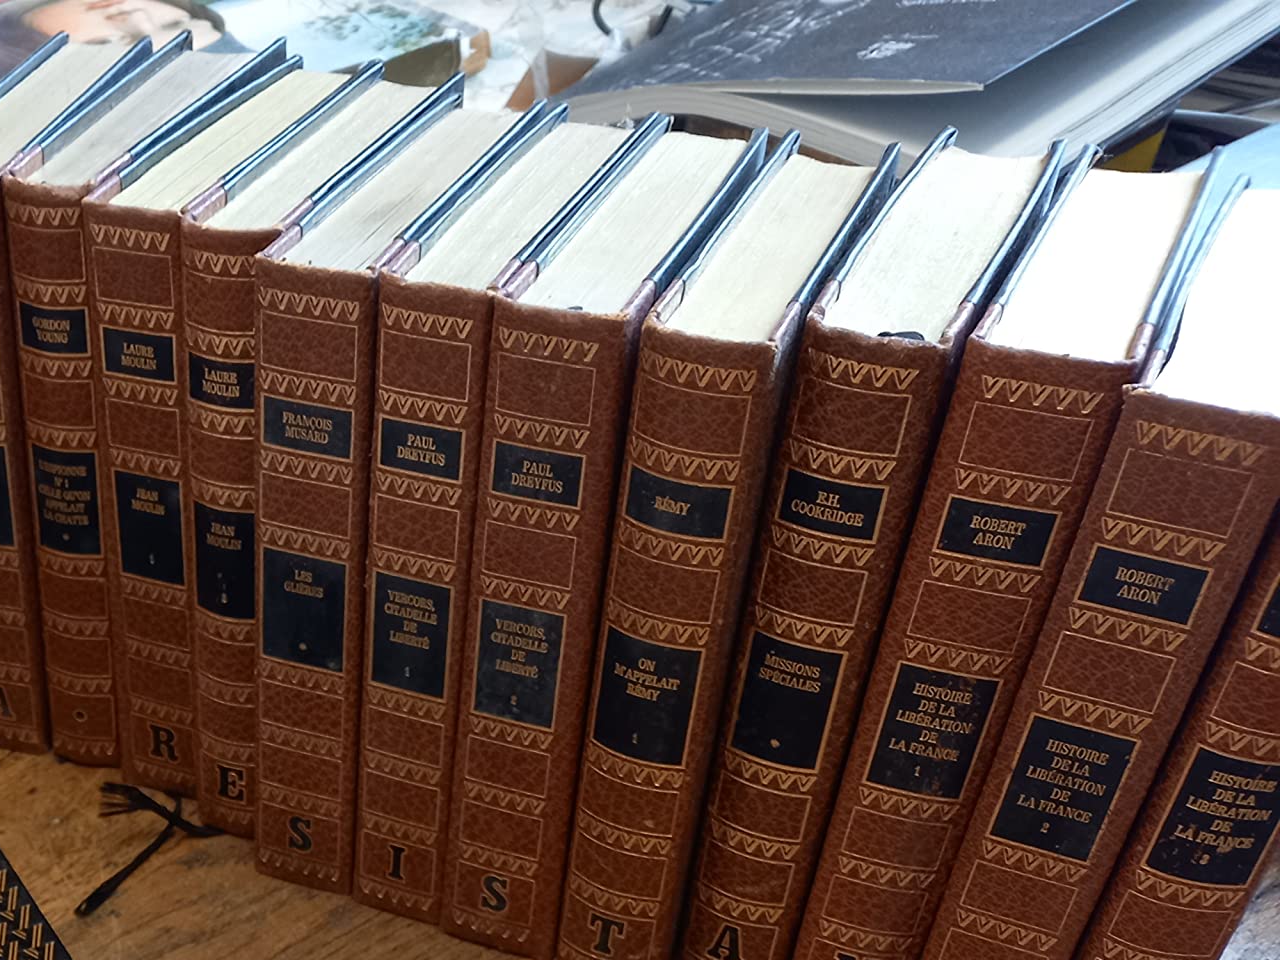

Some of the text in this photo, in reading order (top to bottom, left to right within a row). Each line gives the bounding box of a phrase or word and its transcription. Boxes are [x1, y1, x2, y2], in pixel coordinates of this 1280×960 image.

[32, 316, 70, 331] GORDON
[35, 329, 69, 344] YOUNG
[123, 342, 154, 358] LAURE
[121, 354, 157, 370] MOULIN
[204, 368, 237, 384] LAURE
[202, 380, 240, 398] MOULIN
[282, 411, 333, 431] FRANÇOIS
[285, 425, 329, 445] MUSARD
[407, 433, 436, 451] PAUL
[397, 446, 446, 466] DREYFUS
[522, 460, 554, 478] PAUL
[511, 473, 564, 494] DREYFUS
[136, 488, 159, 501] JEAN
[653, 496, 691, 516] RÉMY
[791, 499, 865, 528] COOKRIDGE
[211, 522, 236, 537] JEAN
[969, 514, 1027, 537] ROBERT
[972, 531, 1016, 551] ARON
[294, 569, 313, 583] LES
[1114, 566, 1176, 592] ROBERT
[387, 590, 436, 612] VERCORS,
[1116, 585, 1163, 606] ARON
[384, 604, 438, 626] CITADELLE
[403, 621, 418, 634] DE
[495, 618, 547, 641] VERCORS,
[389, 630, 431, 650] LIBERTÉ
[490, 632, 549, 654] CITADELLE
[511, 649, 527, 663] DE
[637, 657, 657, 672] ON
[764, 653, 821, 679] MISSIONS
[495, 659, 539, 679] LIBERTÉ
[613, 662, 681, 691] M'APPELAIT
[758, 666, 822, 693] SPÉCIALES
[625, 683, 661, 702] RÉMY
[912, 682, 973, 705] HISTOIRE
[918, 700, 956, 718] DE LA
[895, 709, 973, 735] LIBÉRATION
[148, 723, 179, 762] R
[919, 729, 939, 745] DE
[888, 737, 961, 763] LA FRANCE
[1045, 738, 1110, 767] HISTOIRE
[1050, 755, 1090, 777] DE LA
[216, 763, 247, 803] E
[1025, 765, 1107, 798] LIBÉRATION
[1208, 770, 1278, 793] HISTOIRE
[1050, 787, 1072, 803] DE
[1212, 788, 1257, 807] DE LA
[1017, 793, 1093, 824] LA FRANCE
[1185, 795, 1273, 822] LIBÉRATION
[287, 814, 314, 853] S
[1040, 822, 1051, 834] 2
[1210, 817, 1234, 833] DE
[1174, 823, 1255, 850] LA FRANCE
[385, 843, 408, 882] I
[480, 875, 509, 913] S
[588, 912, 626, 956] T
